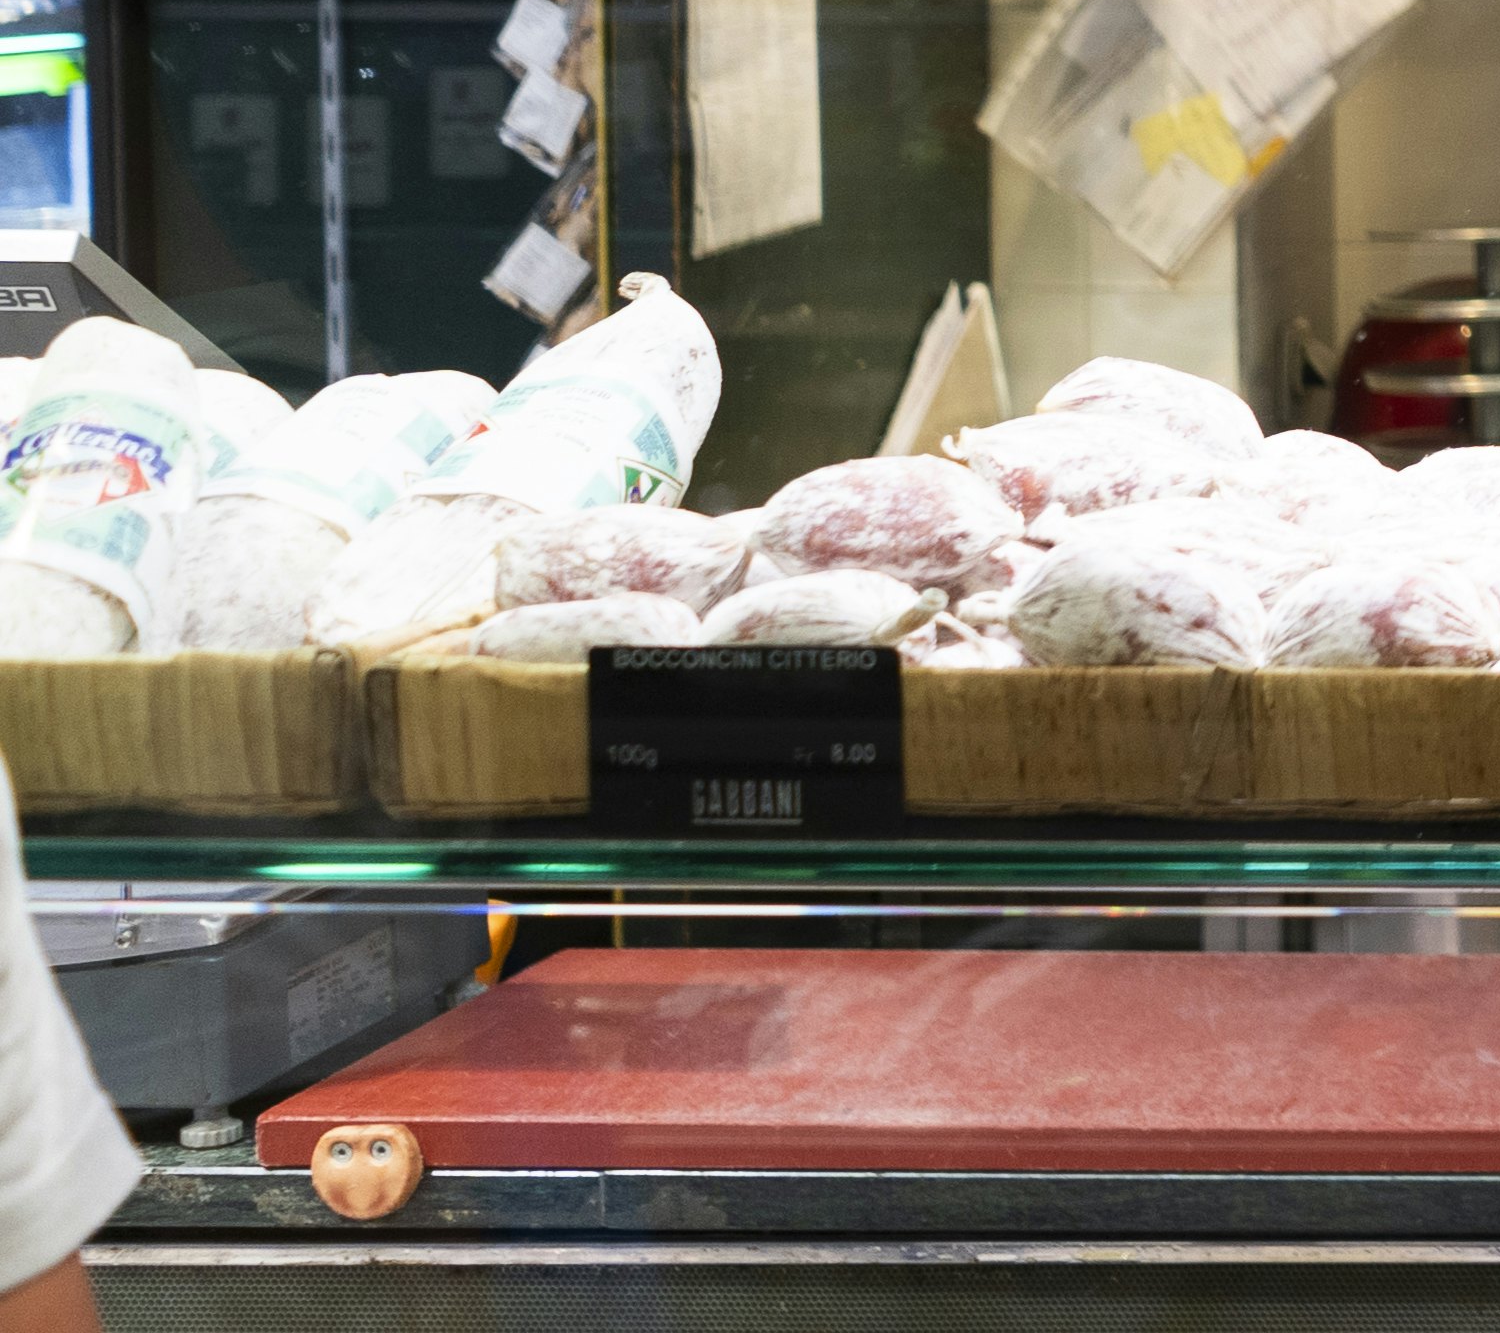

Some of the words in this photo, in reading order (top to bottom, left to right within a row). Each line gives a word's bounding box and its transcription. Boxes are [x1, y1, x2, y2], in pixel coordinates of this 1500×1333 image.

[612, 648, 763, 671] BOCCONCINI
[767, 648, 878, 671] CITTERIO
[606, 744, 659, 769] 100g
